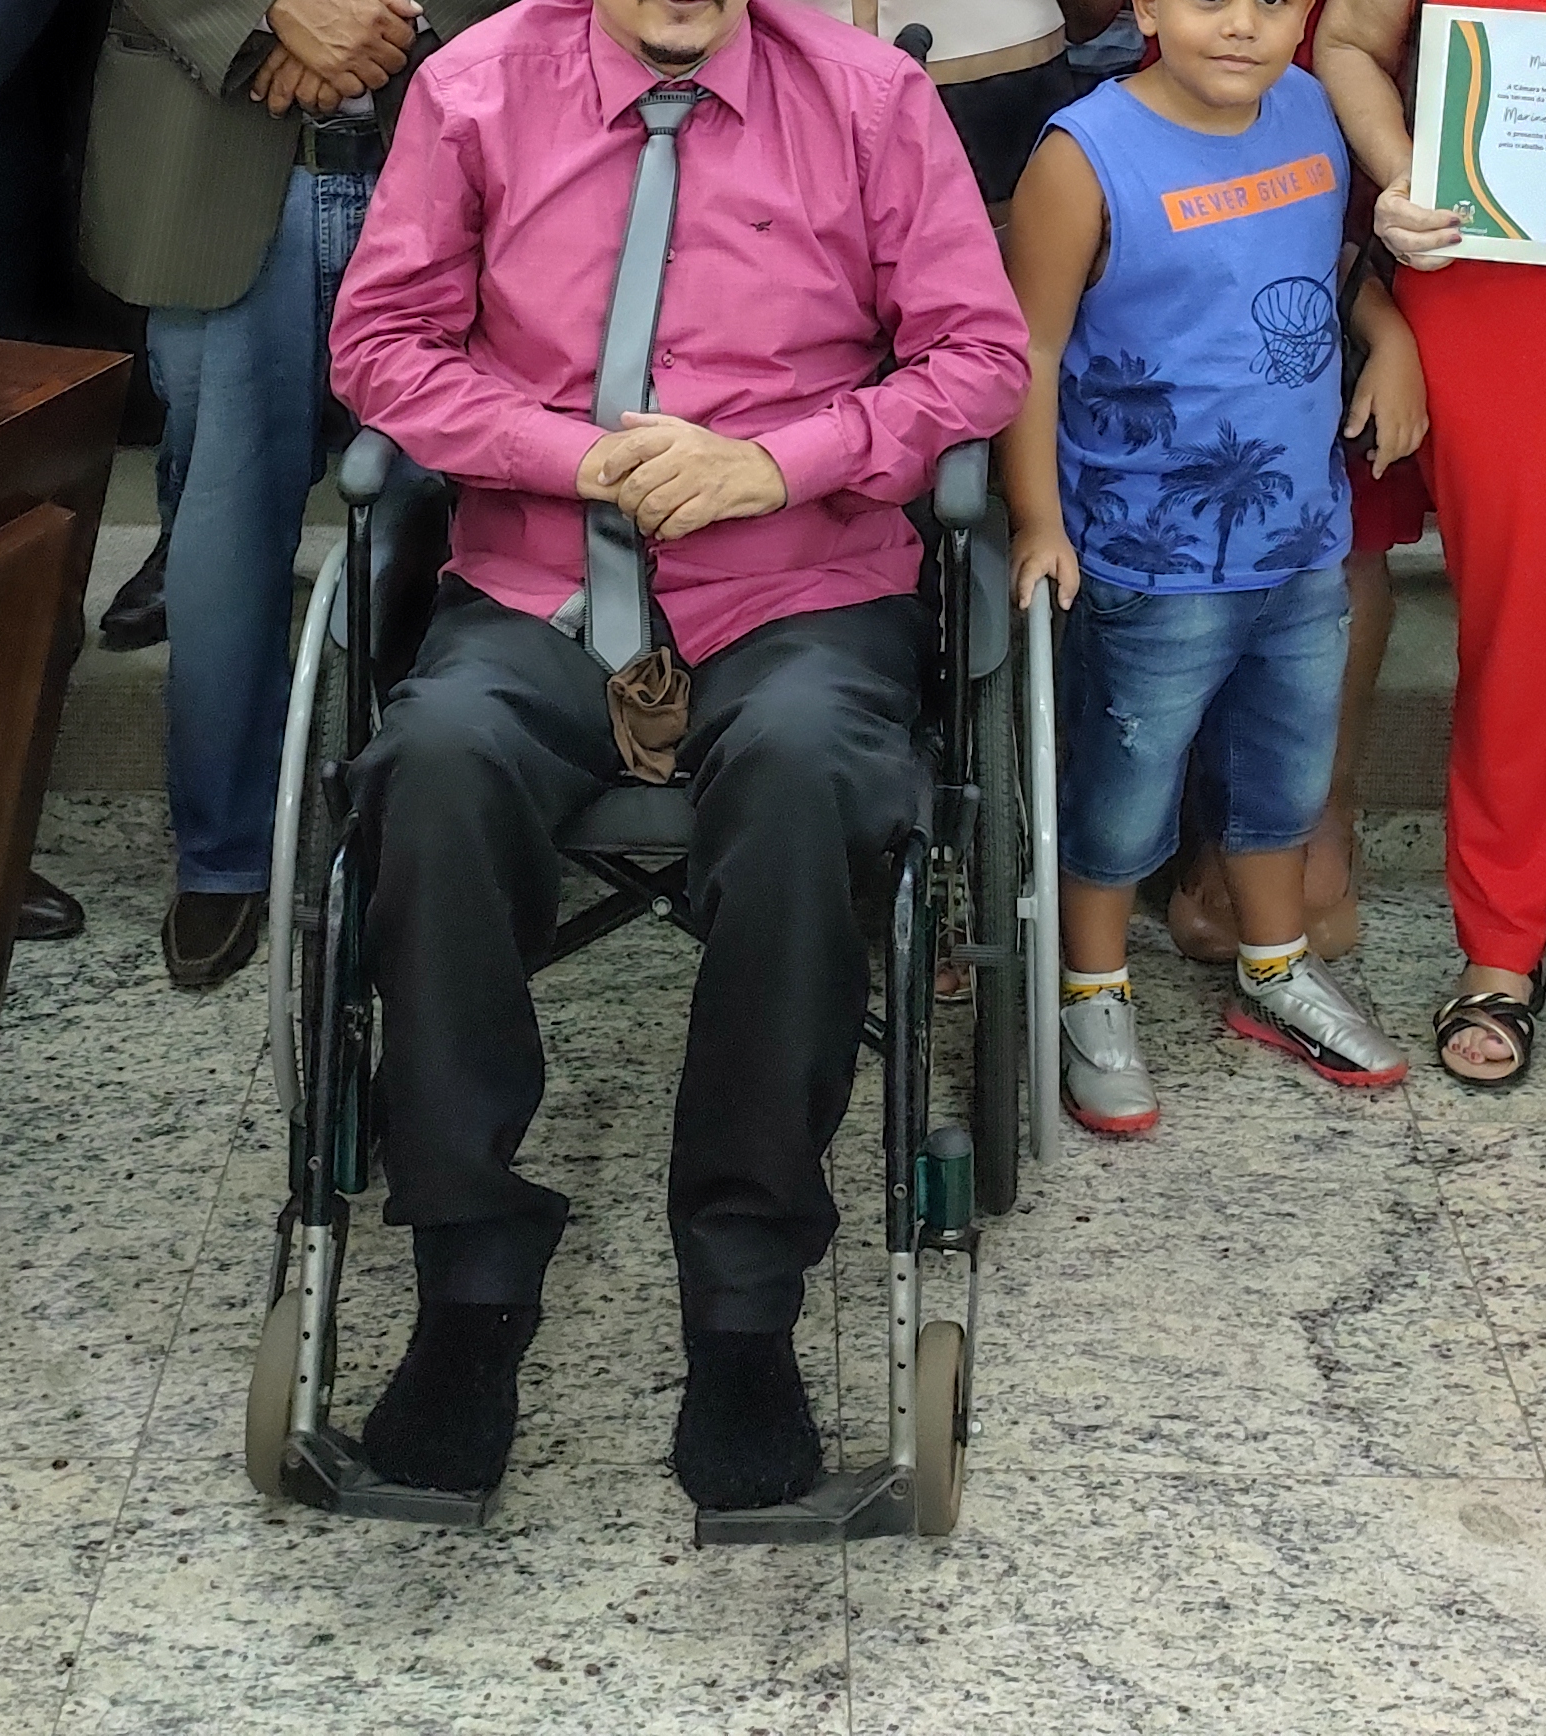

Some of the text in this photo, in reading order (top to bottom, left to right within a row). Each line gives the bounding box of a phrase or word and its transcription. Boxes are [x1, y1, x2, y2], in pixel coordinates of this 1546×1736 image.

[1178, 162, 1326, 220] NEVER GIVE UP
